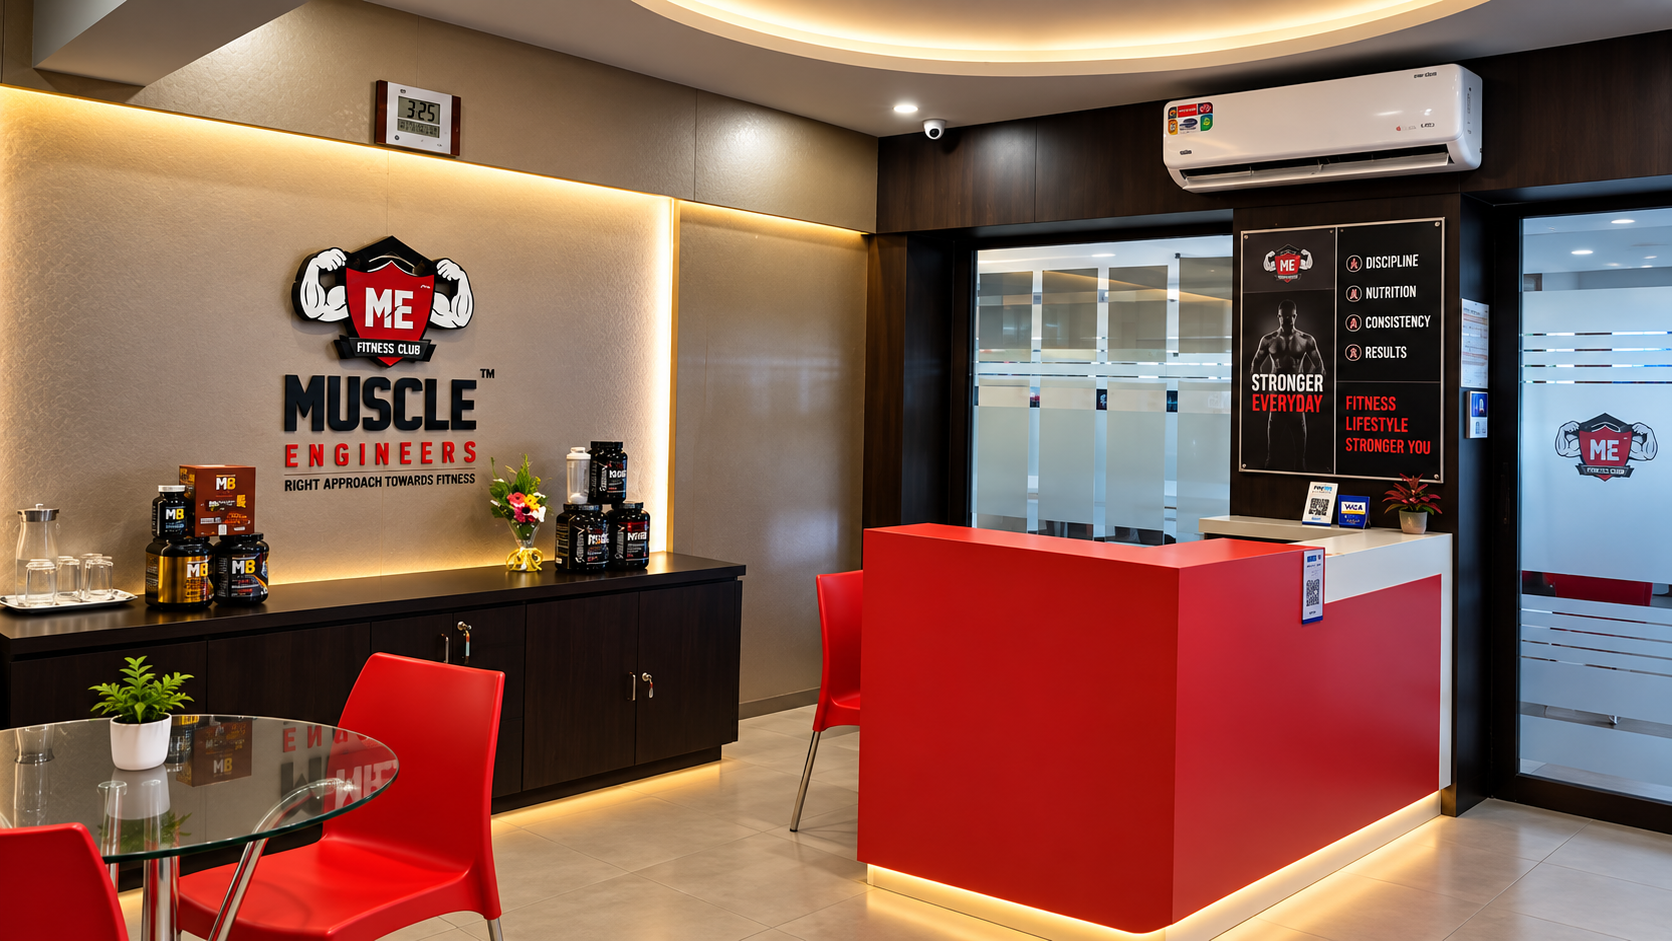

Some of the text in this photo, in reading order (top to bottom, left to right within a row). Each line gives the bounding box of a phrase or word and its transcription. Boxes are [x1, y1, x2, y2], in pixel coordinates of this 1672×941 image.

[1279, 259, 1295, 272] ME
[1365, 254, 1419, 270] DISCIPLINE
[1365, 285, 1417, 299] NUTRITION
[364, 287, 414, 329] ME
[1365, 315, 1431, 329] CONSISTENCY
[357, 341, 421, 355] FITNESS CLUB
[1365, 345, 1408, 359] RESULTS
[1251, 373, 1324, 392] STRONGER
[284, 374, 477, 432] MUSCLE
[1252, 393, 1323, 413] EVERYDAY
[1345, 395, 1397, 411] FITNESS
[1345, 416, 1409, 433] LIFESTYLE
[1345, 437, 1431, 455] STRONGER YOU
[1590, 439, 1620, 461] ME
[285, 441, 477, 468] ENGINEERS
[215, 477, 236, 491] MB
[284, 473, 476, 492] RIGHT APPROACH TOWARDS FITNESS
[165, 508, 185, 520] MB
[187, 562, 208, 578] MB
[231, 559, 256, 575] MB
